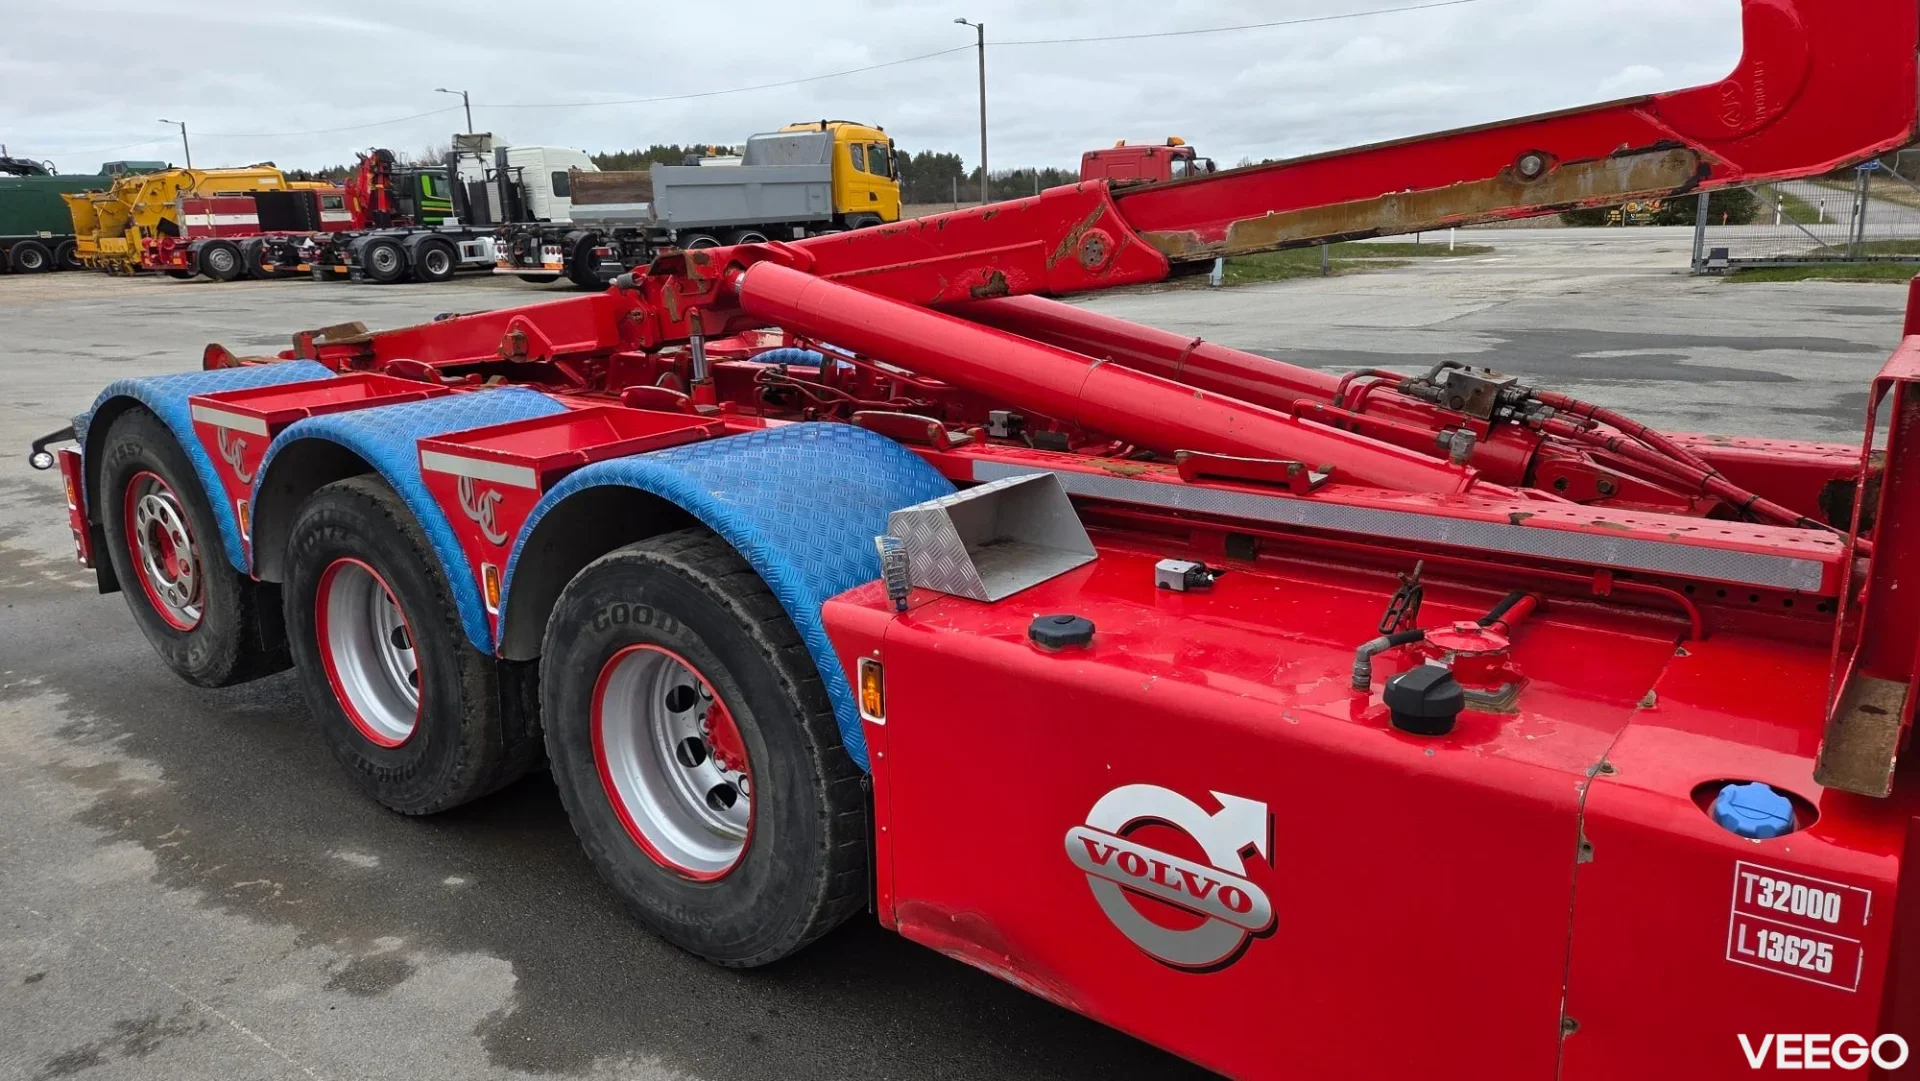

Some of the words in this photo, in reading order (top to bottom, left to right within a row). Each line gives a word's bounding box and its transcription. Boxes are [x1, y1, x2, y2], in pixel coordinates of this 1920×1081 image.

[1077, 835, 1254, 914] VOLVO
[1741, 871, 1841, 924] T32000
[1737, 923, 1834, 974] L13625
